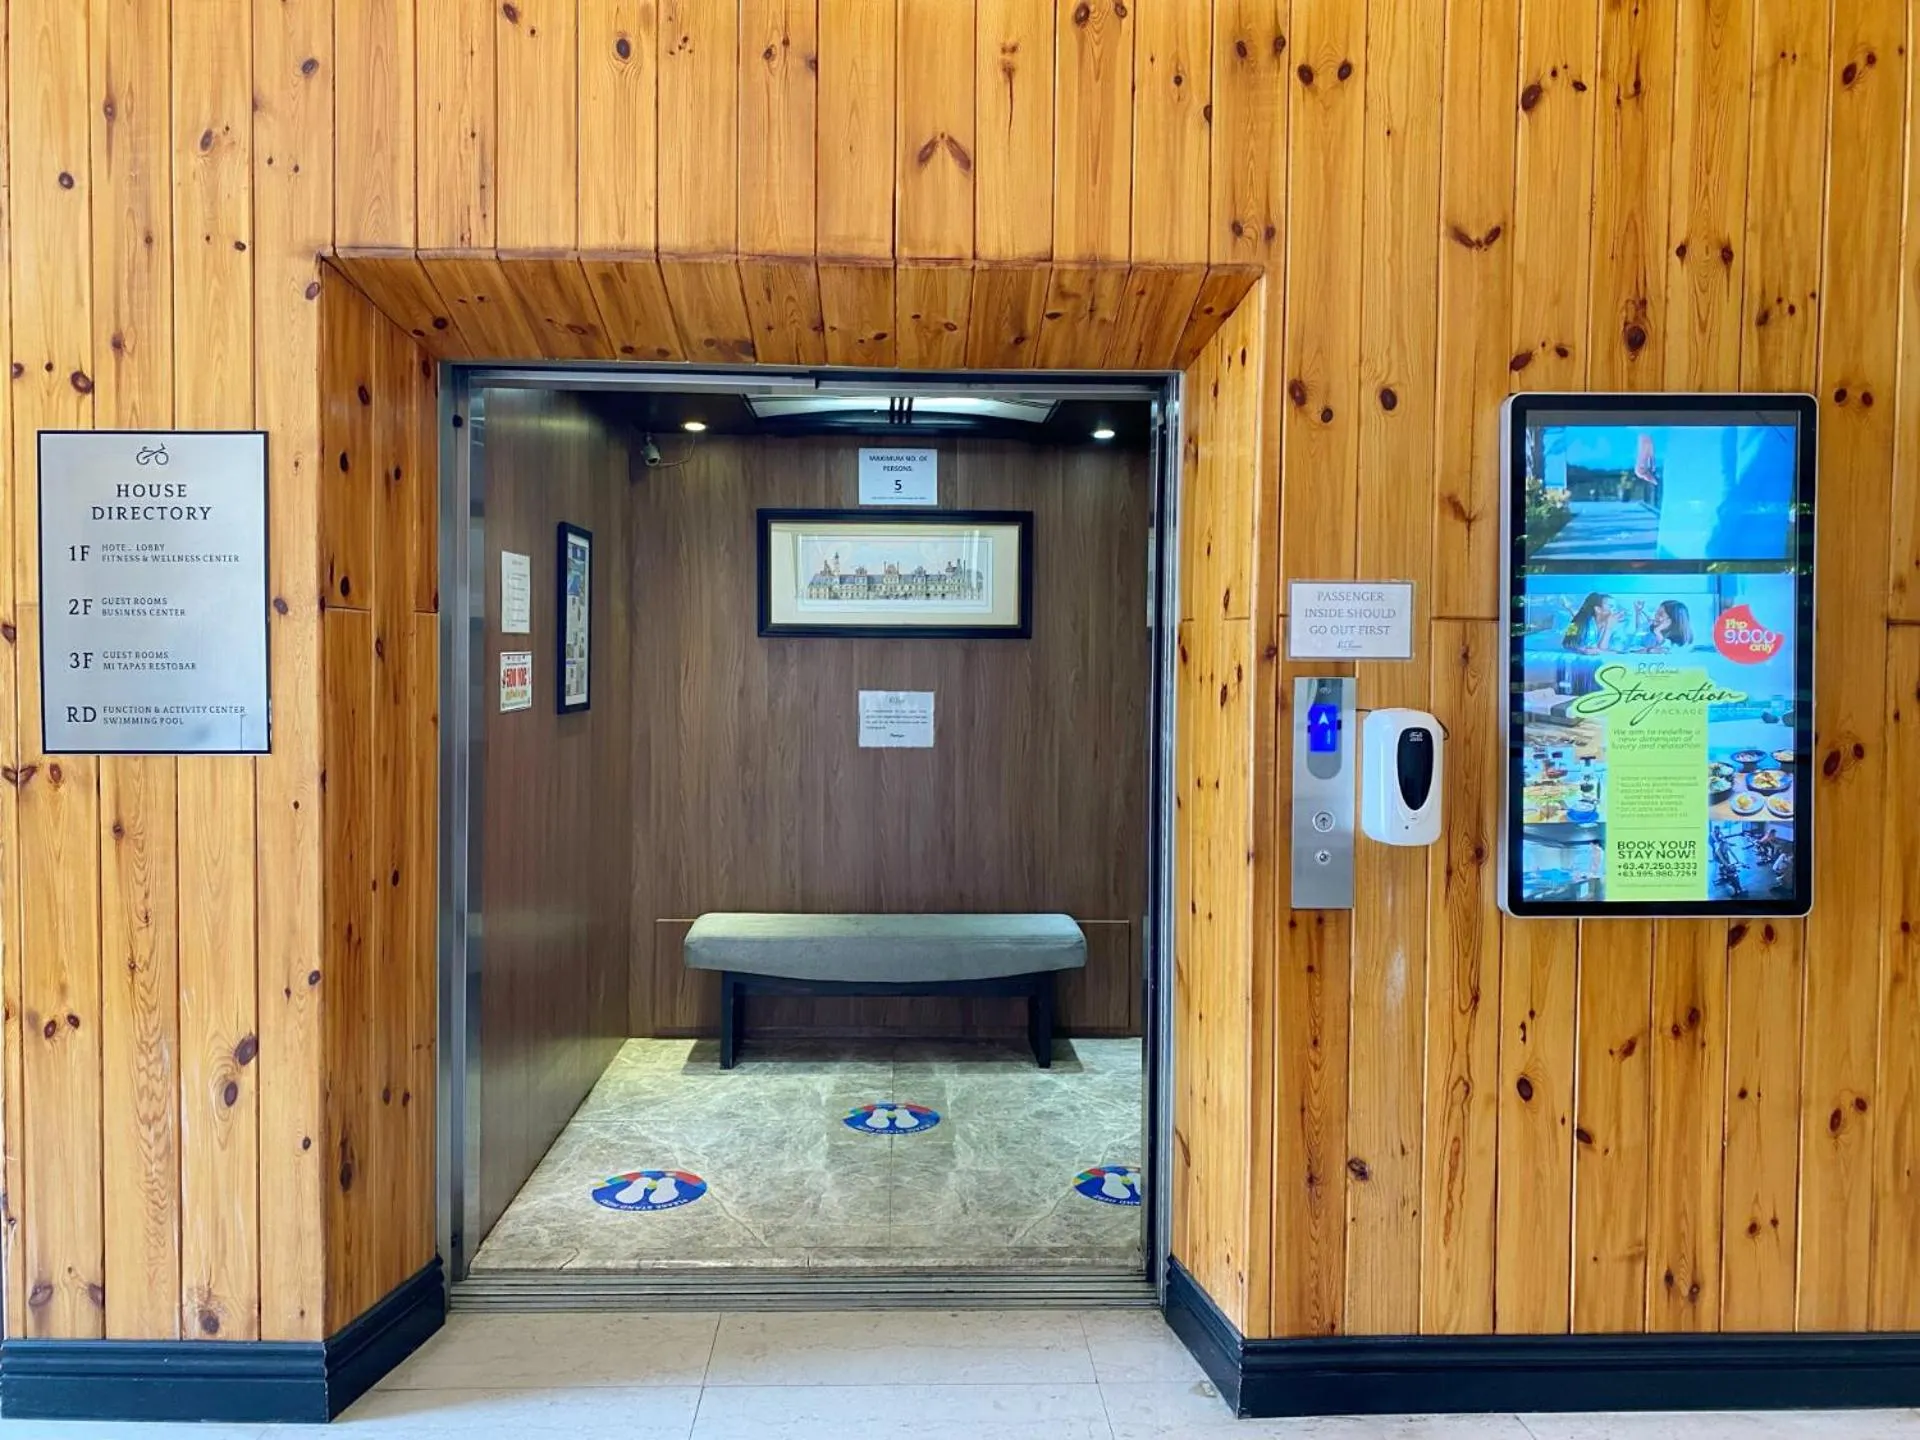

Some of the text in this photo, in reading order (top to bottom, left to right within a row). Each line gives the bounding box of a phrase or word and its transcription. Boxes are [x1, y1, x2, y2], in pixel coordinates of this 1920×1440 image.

[894, 479, 902, 491] 5
[116, 484, 188, 498] HOUSE
[92, 506, 212, 521] DIRECTORY
[136, 543, 165, 552] LOBBY
[69, 545, 90, 562] 1F
[102, 554, 140, 562] FITNESS
[150, 554, 201, 562] WELLNESS
[202, 554, 240, 562] CENTER
[102, 597, 168, 605] GUEST ROOMS
[1317, 592, 1385, 601] PASSENGER
[69, 598, 93, 615] 2F
[102, 608, 186, 617] BUSINESS CENTER
[1304, 608, 1396, 618] INSIDE SHOULD
[1309, 625, 1391, 635] GO OUT FIRST
[1724, 628, 1776, 645] 9,000
[102, 651, 169, 659] GUEST ROOMS
[69, 652, 93, 669] 3F
[103, 662, 197, 670] MI TAPAS RESTOBAR
[1576, 666, 1742, 726] Staycation
[66, 706, 97, 723] RD
[103, 706, 151, 714] FUNCTION
[163, 706, 206, 714] ACTIVITY
[209, 706, 246, 714] CENTER
[1655, 708, 1704, 716] PACKAGE
[103, 717, 185, 725] SWIMMING POOL
[1617, 840, 1697, 850] BOOK YOUR
[1618, 849, 1697, 859] STAY NOW!
